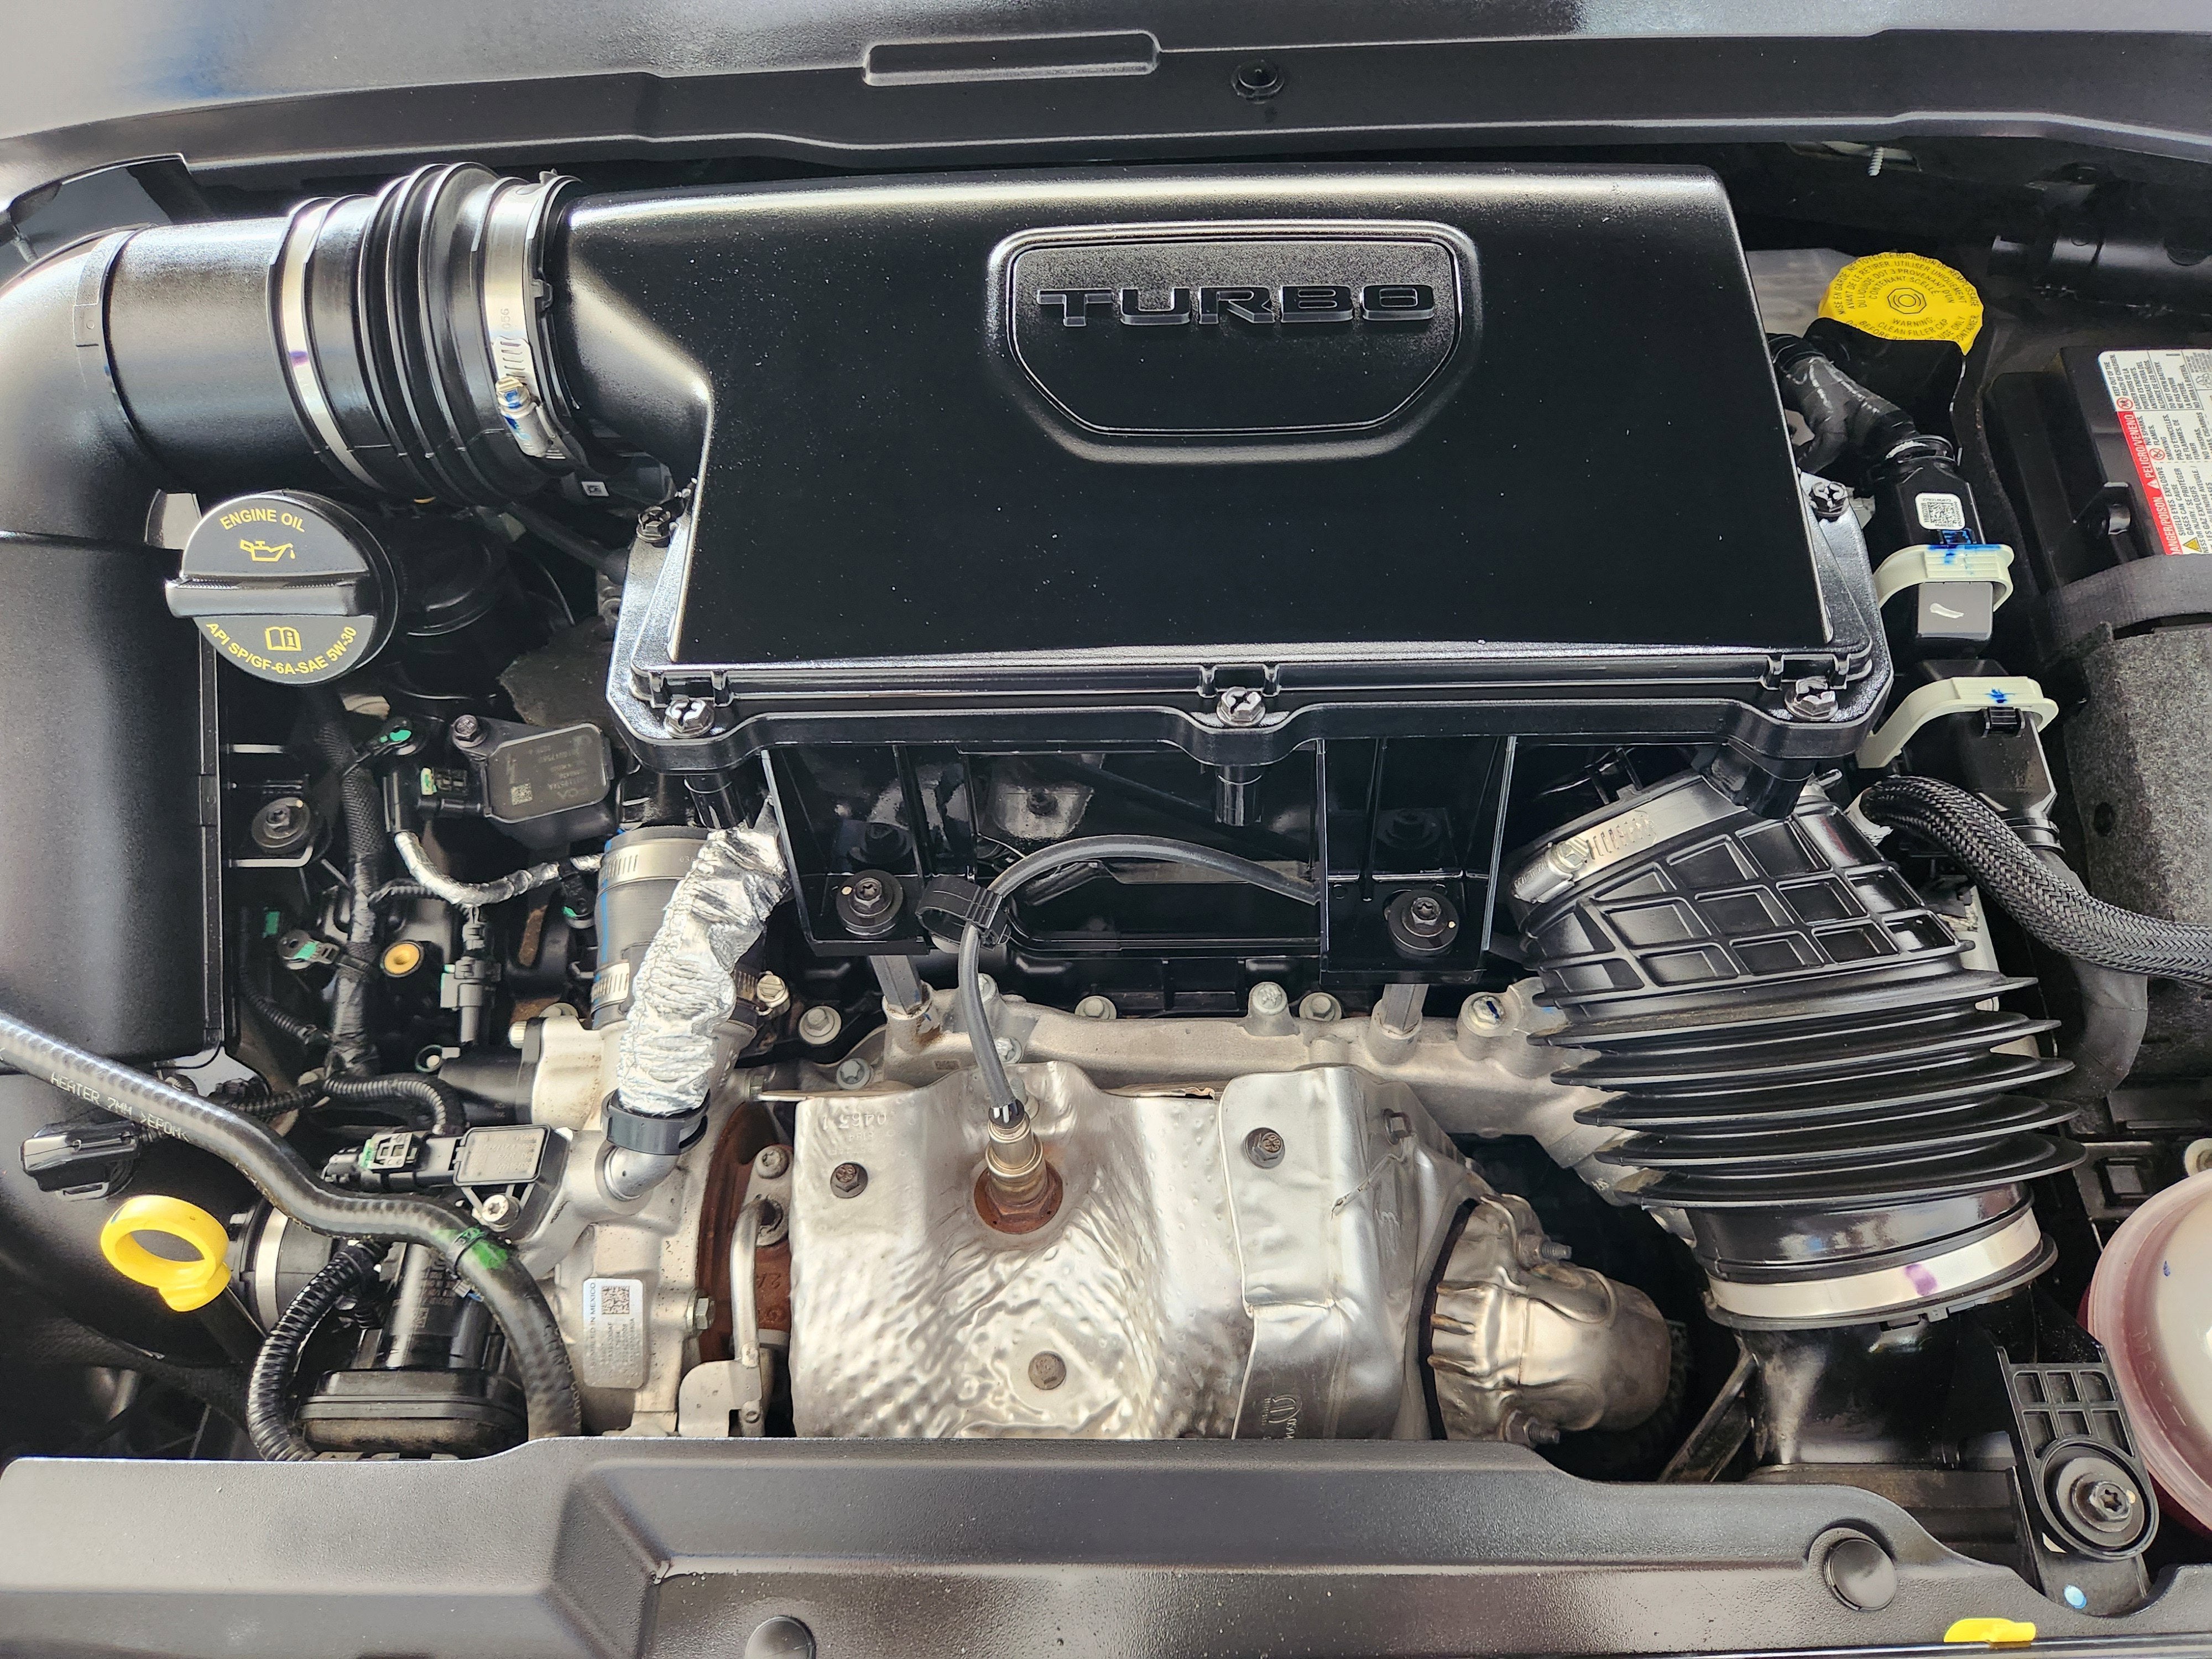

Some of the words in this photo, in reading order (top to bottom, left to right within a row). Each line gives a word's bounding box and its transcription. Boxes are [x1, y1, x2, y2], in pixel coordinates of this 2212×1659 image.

[1894, 260, 1931, 272] UTILISER
[1847, 281, 1857, 290] DE
[1851, 274, 1863, 283] LE
[1872, 269, 1888, 279] DOT
[1898, 268, 1945, 289] PROVENANT
[1036, 284, 1434, 327] TURBO
[1877, 321, 1906, 336] CLEAN
[1907, 326, 1936, 337] FILLER
[1935, 318, 1949, 330] CAP
[1937, 329, 1950, 339] USE
[2109, 377, 2117, 385] OUT
[2127, 380, 2135, 392] HORS
[2161, 381, 2170, 392] OPEN
[2112, 386, 2121, 396] KEEP
[2119, 382, 2128, 396] REACH
[2154, 389, 2166, 409] ALCANCE
[2166, 393, 2174, 402] NOT
[2174, 393, 2182, 402] PAS
[2197, 412, 2210, 437] CIGARROS
[2124, 414, 2154, 478] PELIGRO/VENENO
[2161, 436, 2174, 460] SMOKING
[2189, 442, 2200, 460] FUMER
[2174, 448, 2184, 460] PAS
[2202, 451, 2210, 460] NO
[2156, 467, 2172, 497] EXPLOSIVE
[2171, 484, 2182, 501] CAUSE
[2178, 503, 2187, 514] CAN
[2189, 486, 2205, 517] EXPLOSIFS
[220, 508, 277, 530] ENGINE
[281, 513, 305, 533] OIL
[2173, 515, 2185, 536] SHIELD
[2183, 517, 2194, 535] GASES
[2200, 518, 2210, 530] GAZ
[206, 623, 231, 645] API
[325, 626, 357, 661] 5W-30
[50, 1071, 101, 1105] HEATER
[106, 1097, 132, 1116] 7MM
[589, 1317, 596, 1325] IN
